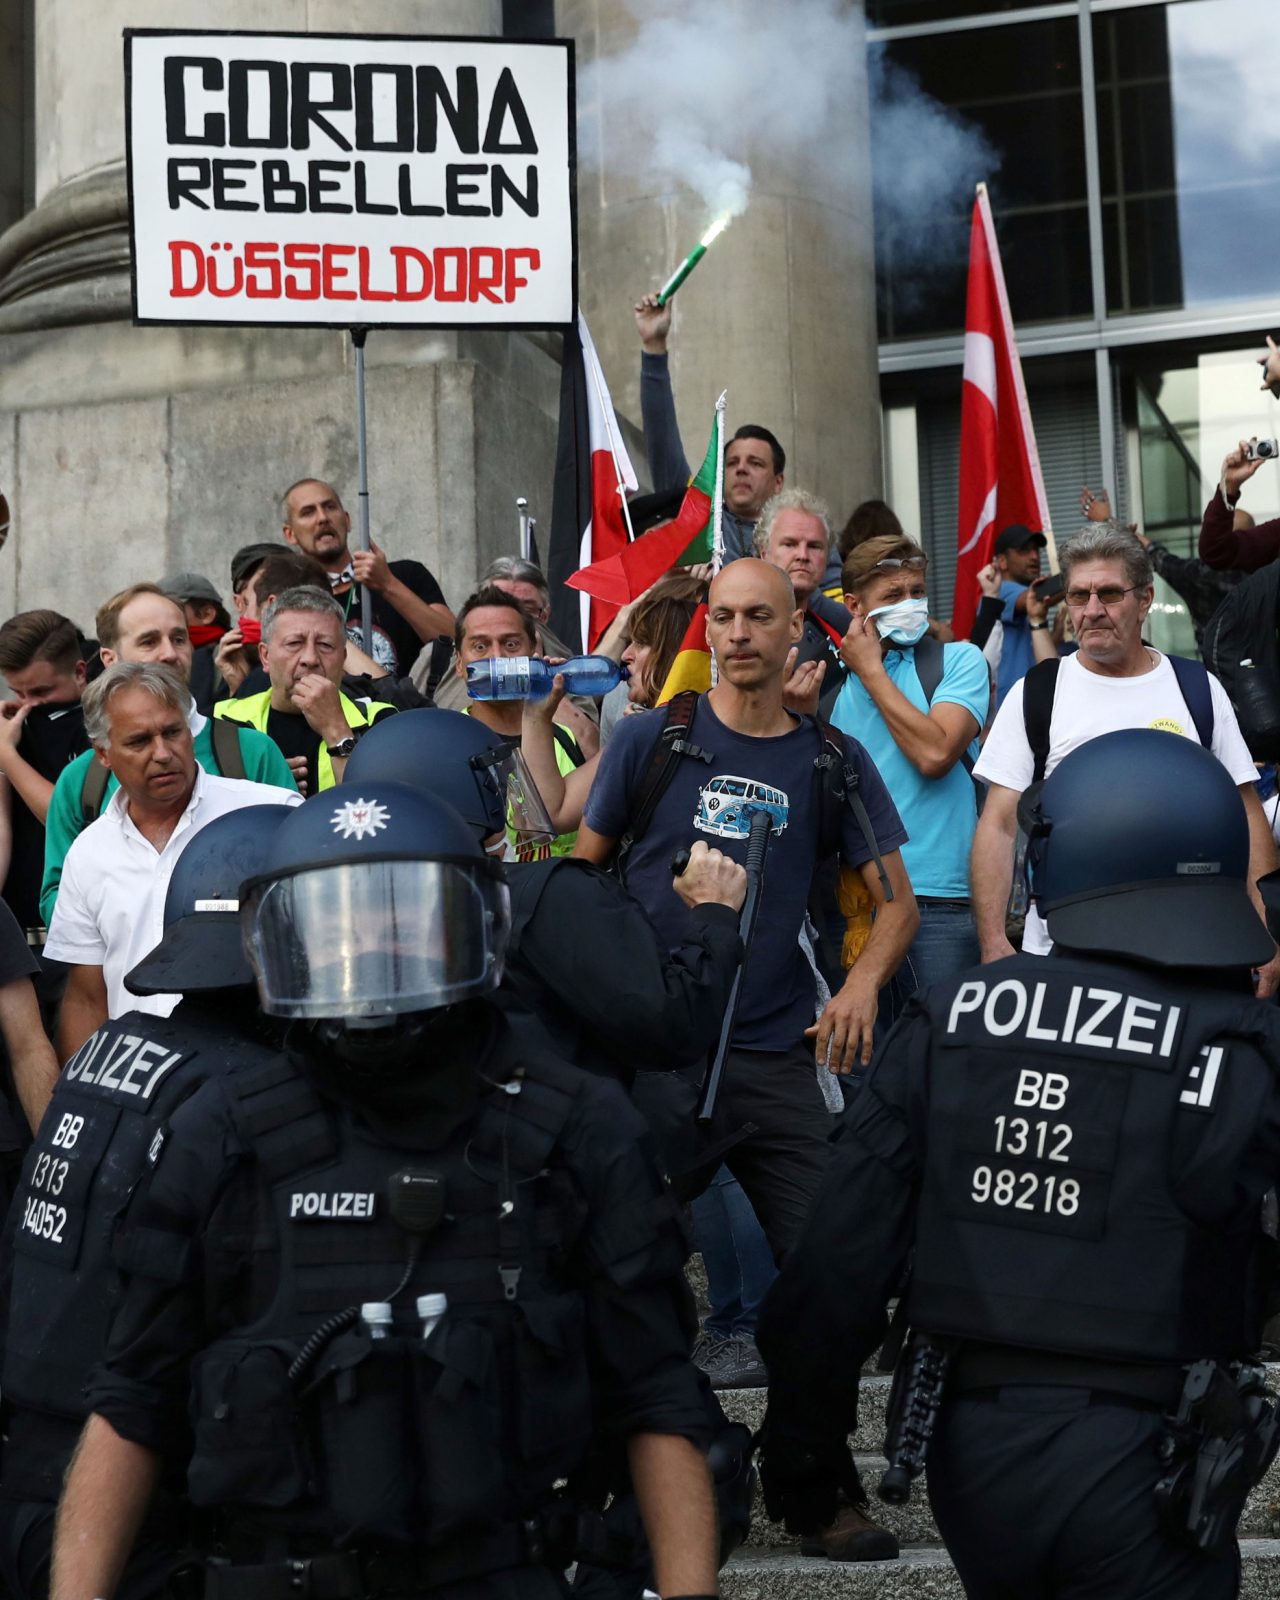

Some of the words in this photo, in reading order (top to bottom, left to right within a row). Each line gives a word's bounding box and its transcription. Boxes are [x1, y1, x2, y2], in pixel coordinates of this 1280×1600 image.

[164, 56, 539, 155] CORONA
[167, 157, 539, 217] REBELLEN
[168, 240, 540, 304] DÜSSELDORF
[947, 979, 1181, 1057] POLIZEI
[62, 1030, 182, 1099] OLIZEI
[1014, 1069, 1070, 1111] BB
[52, 1112, 84, 1149] BB
[994, 1115, 1073, 1162] 1312
[31, 1152, 69, 1196] 1313
[971, 1165, 1080, 1216] 98218
[290, 1192, 375, 1217] POLIZEI
